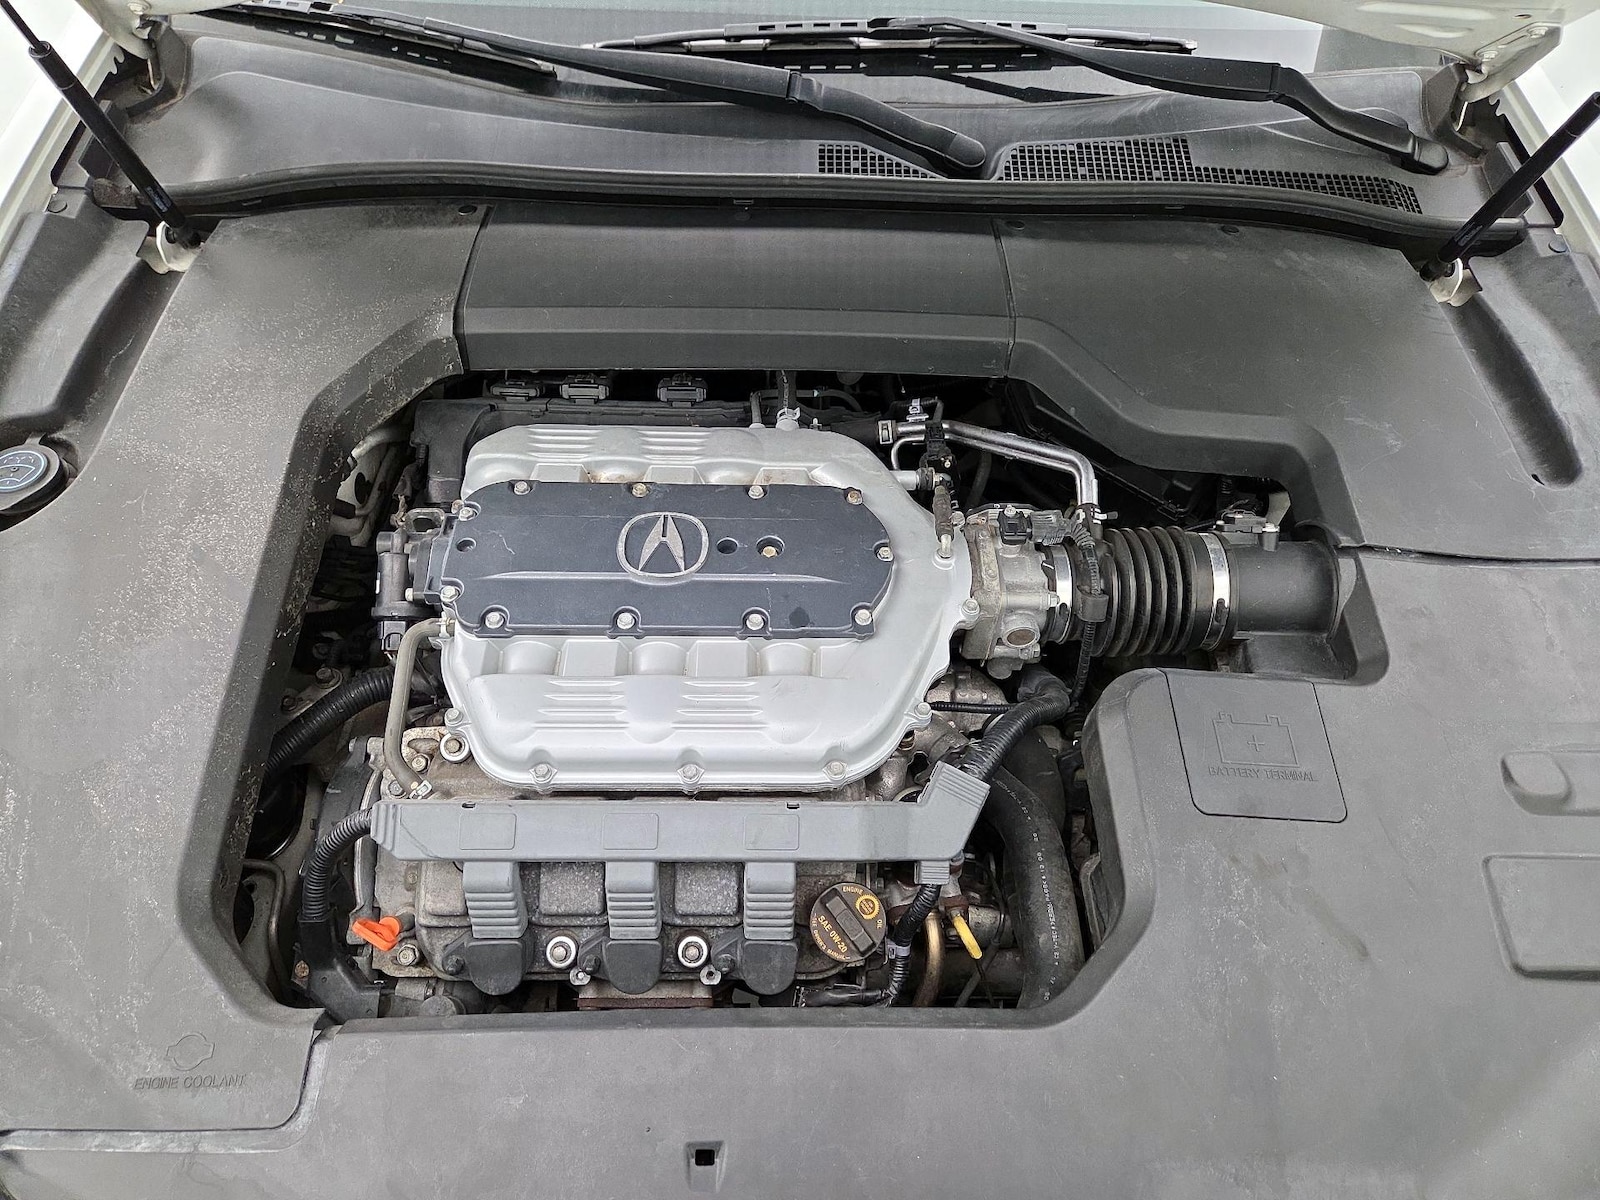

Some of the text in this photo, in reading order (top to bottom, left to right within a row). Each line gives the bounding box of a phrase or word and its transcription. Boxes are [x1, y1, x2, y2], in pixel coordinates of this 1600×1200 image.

[1208, 766, 1319, 782] BATTERY TERMINAL
[842, 886, 864, 895] ENGINE
[818, 915, 848, 953] SAE 0W-20
[133, 1074, 247, 1090] ENGINE COOLANT
